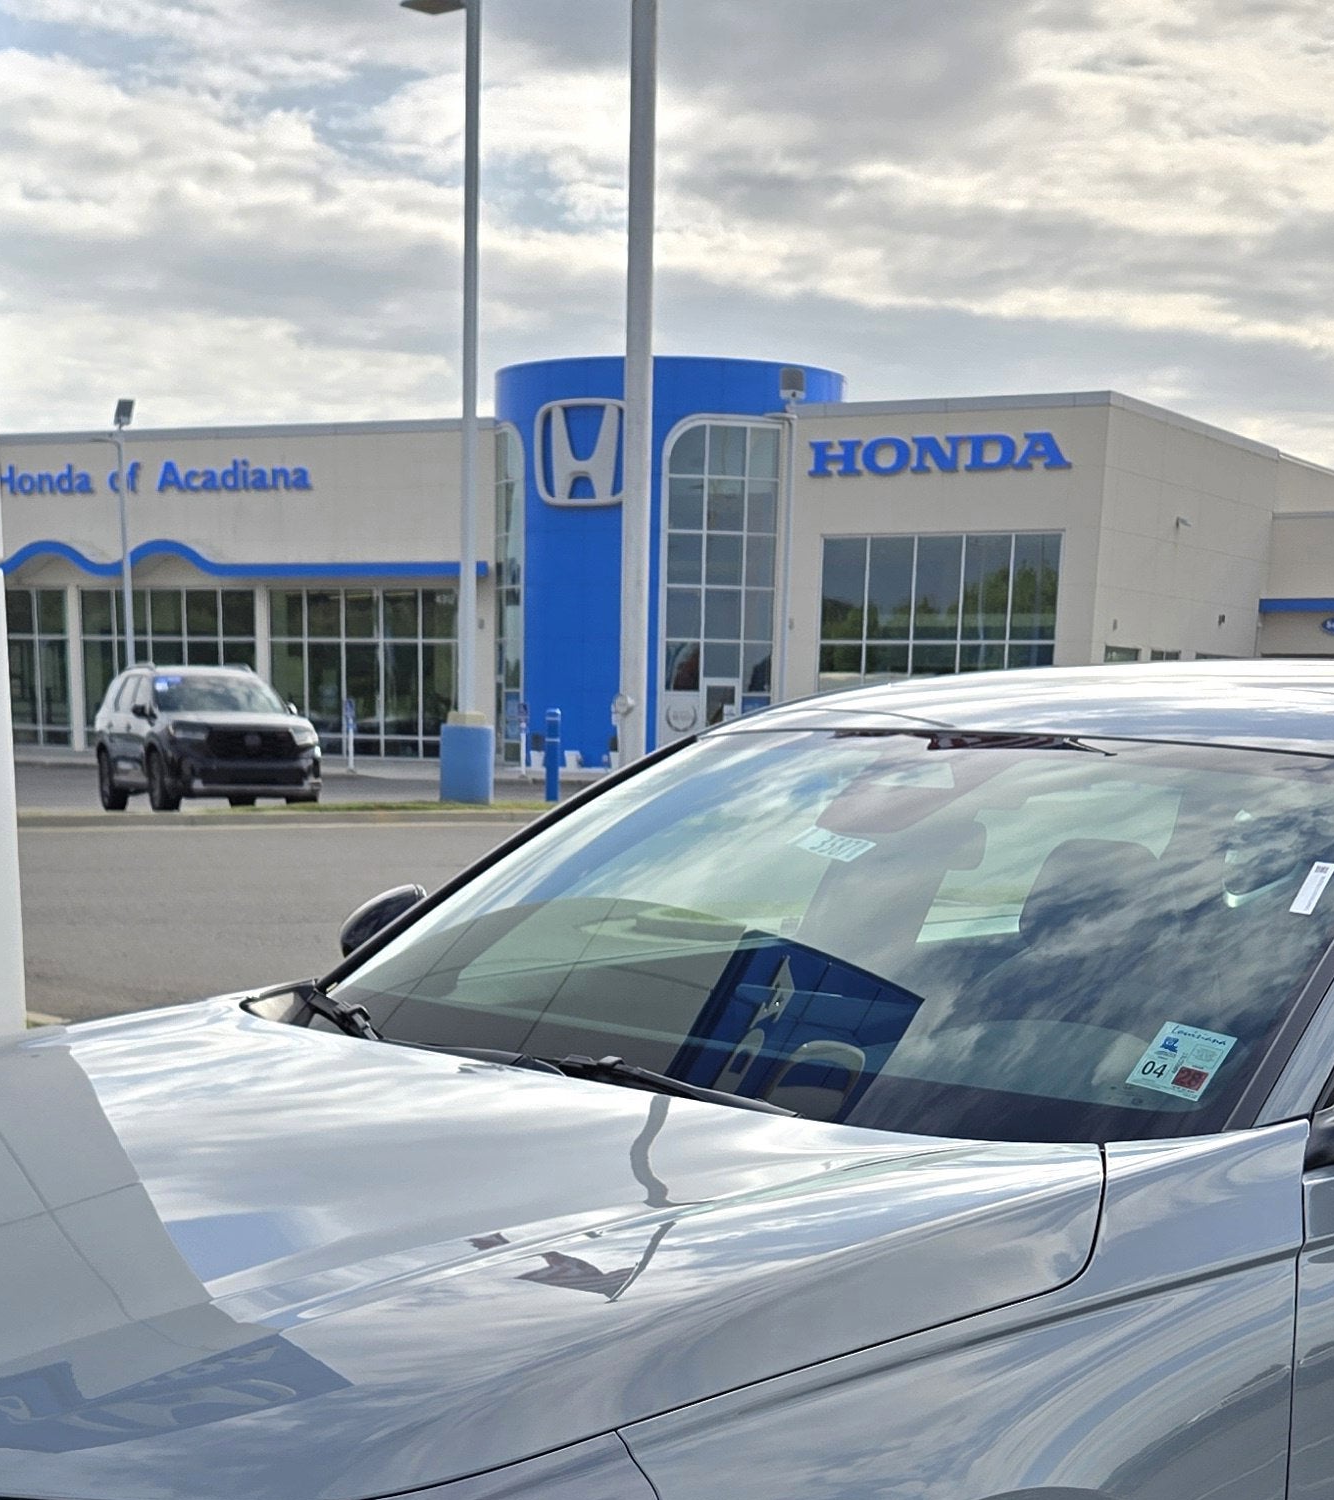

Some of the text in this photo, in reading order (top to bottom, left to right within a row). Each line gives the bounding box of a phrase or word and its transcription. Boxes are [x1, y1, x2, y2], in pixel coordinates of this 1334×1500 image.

[808, 432, 1072, 477] HONDA
[157, 458, 313, 491] Acadiana
[1171, 1024, 1226, 1046] Louisiana
[1141, 1060, 1168, 1078] 04
